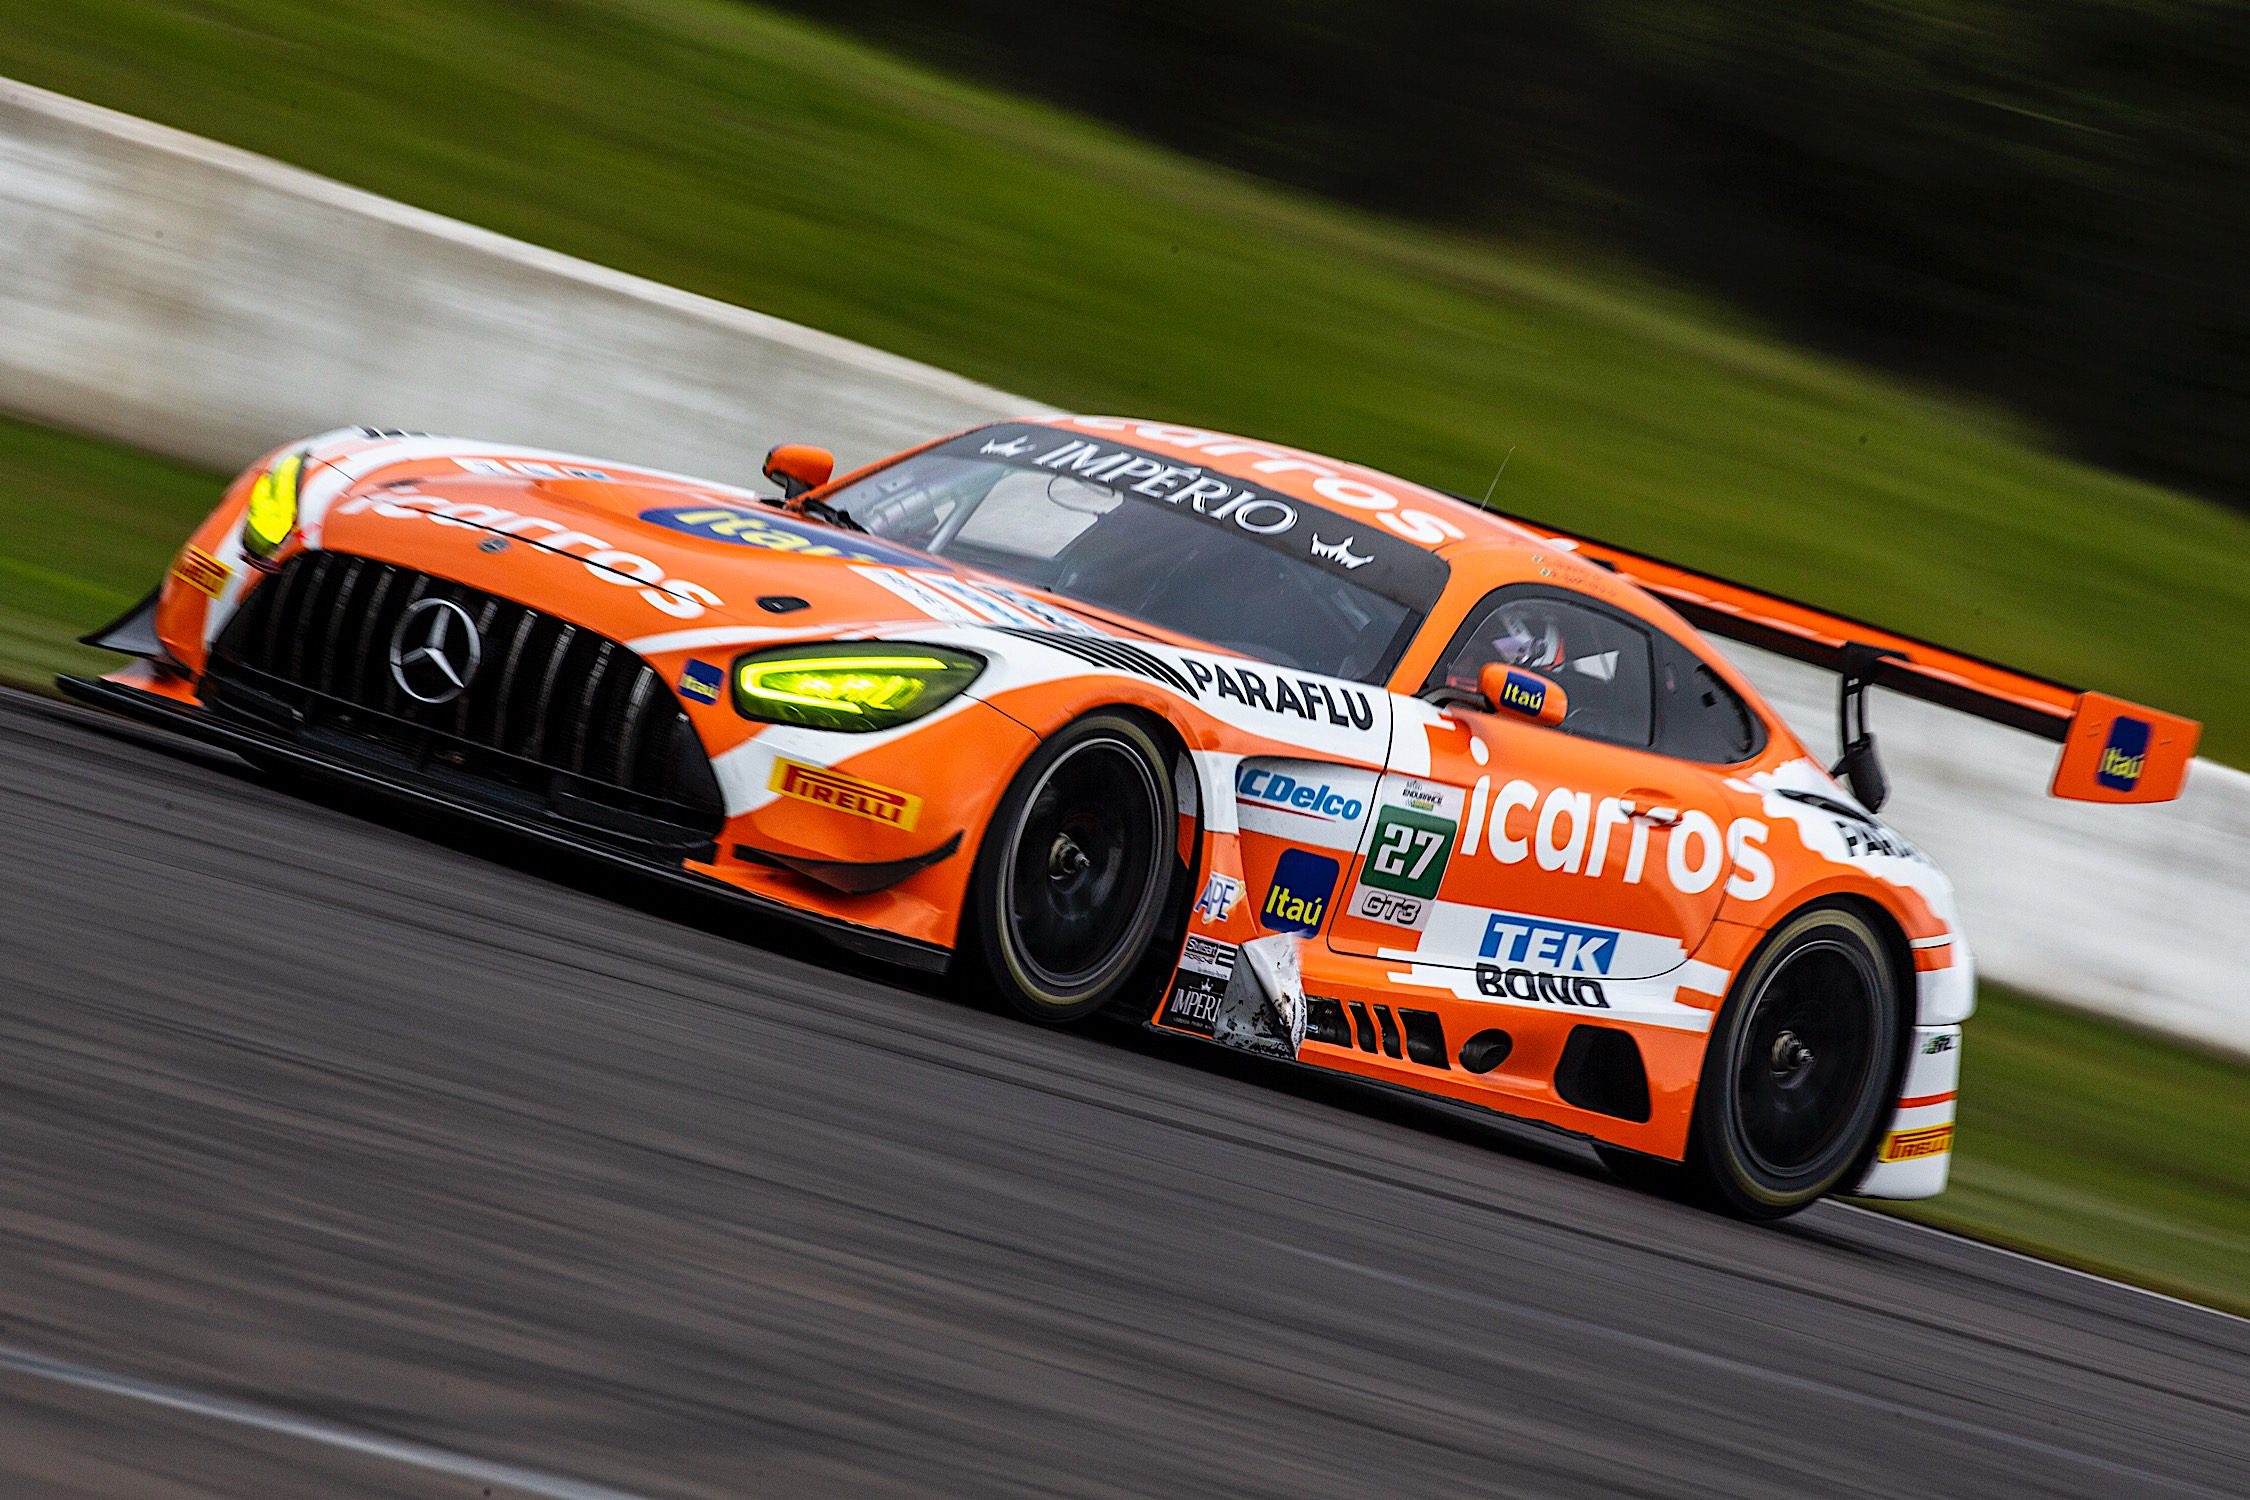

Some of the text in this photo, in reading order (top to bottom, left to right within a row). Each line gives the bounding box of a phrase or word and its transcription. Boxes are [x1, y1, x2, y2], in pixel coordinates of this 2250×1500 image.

[1032, 439, 1299, 536] IMPÉRIO
[338, 485, 724, 620] icarros
[1178, 656, 1373, 731] PARAFLU
[1504, 682, 1543, 711] Itaú
[2098, 746, 2145, 779] Itaú
[781, 763, 907, 823] PIRELLI
[1459, 735, 1776, 901] icarros
[1373, 822, 1446, 881] 27
[1265, 884, 1324, 926] Itaú
[1361, 890, 1422, 926] GT3
[1490, 921, 1611, 976] TEK
[1170, 987, 1222, 1023] IMPERI
[1476, 961, 1611, 1009] BOND
